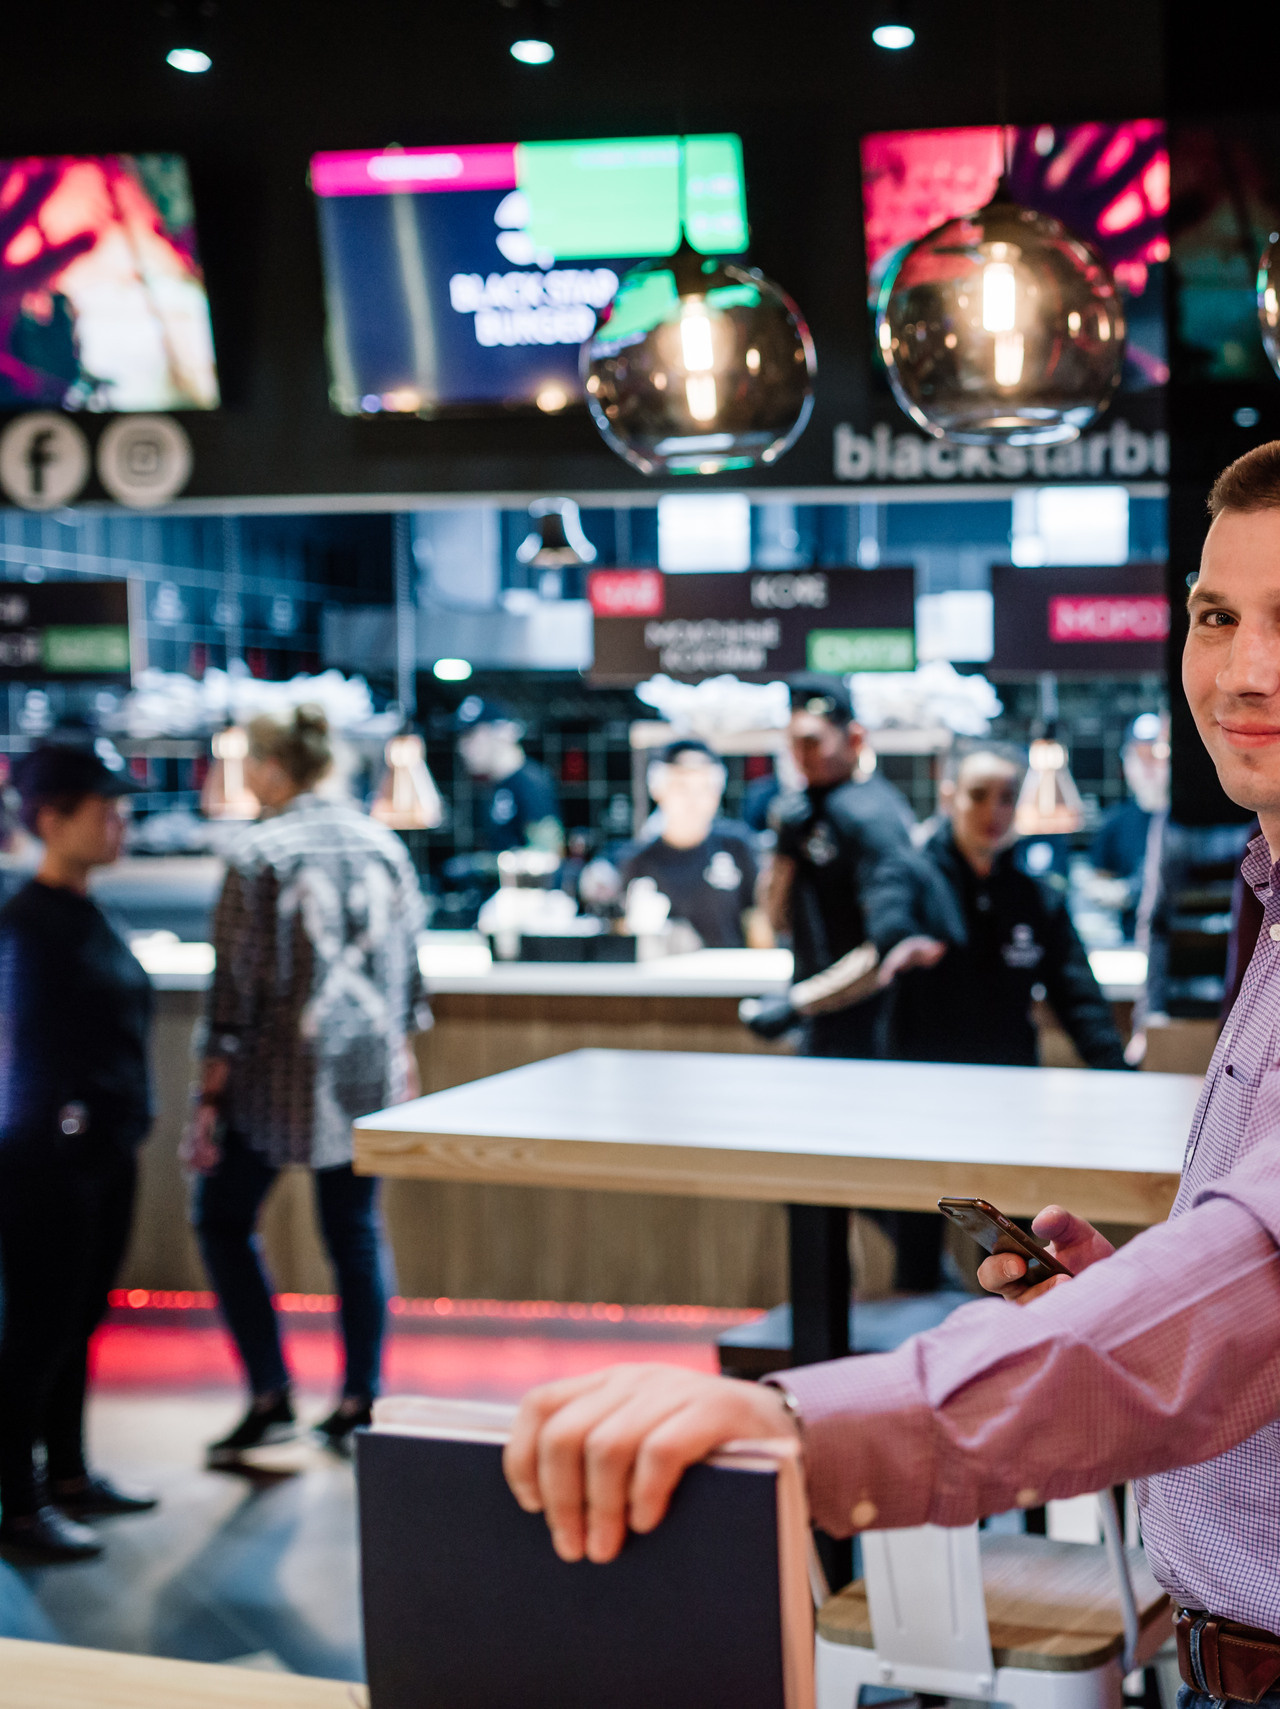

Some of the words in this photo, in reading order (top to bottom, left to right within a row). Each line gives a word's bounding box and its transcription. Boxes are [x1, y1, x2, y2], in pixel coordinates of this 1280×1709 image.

[449, 273, 544, 314] BLACK
[542, 268, 619, 309] STAR
[474, 303, 597, 347] BURGER
[750, 573, 828, 609] КОФЕ
